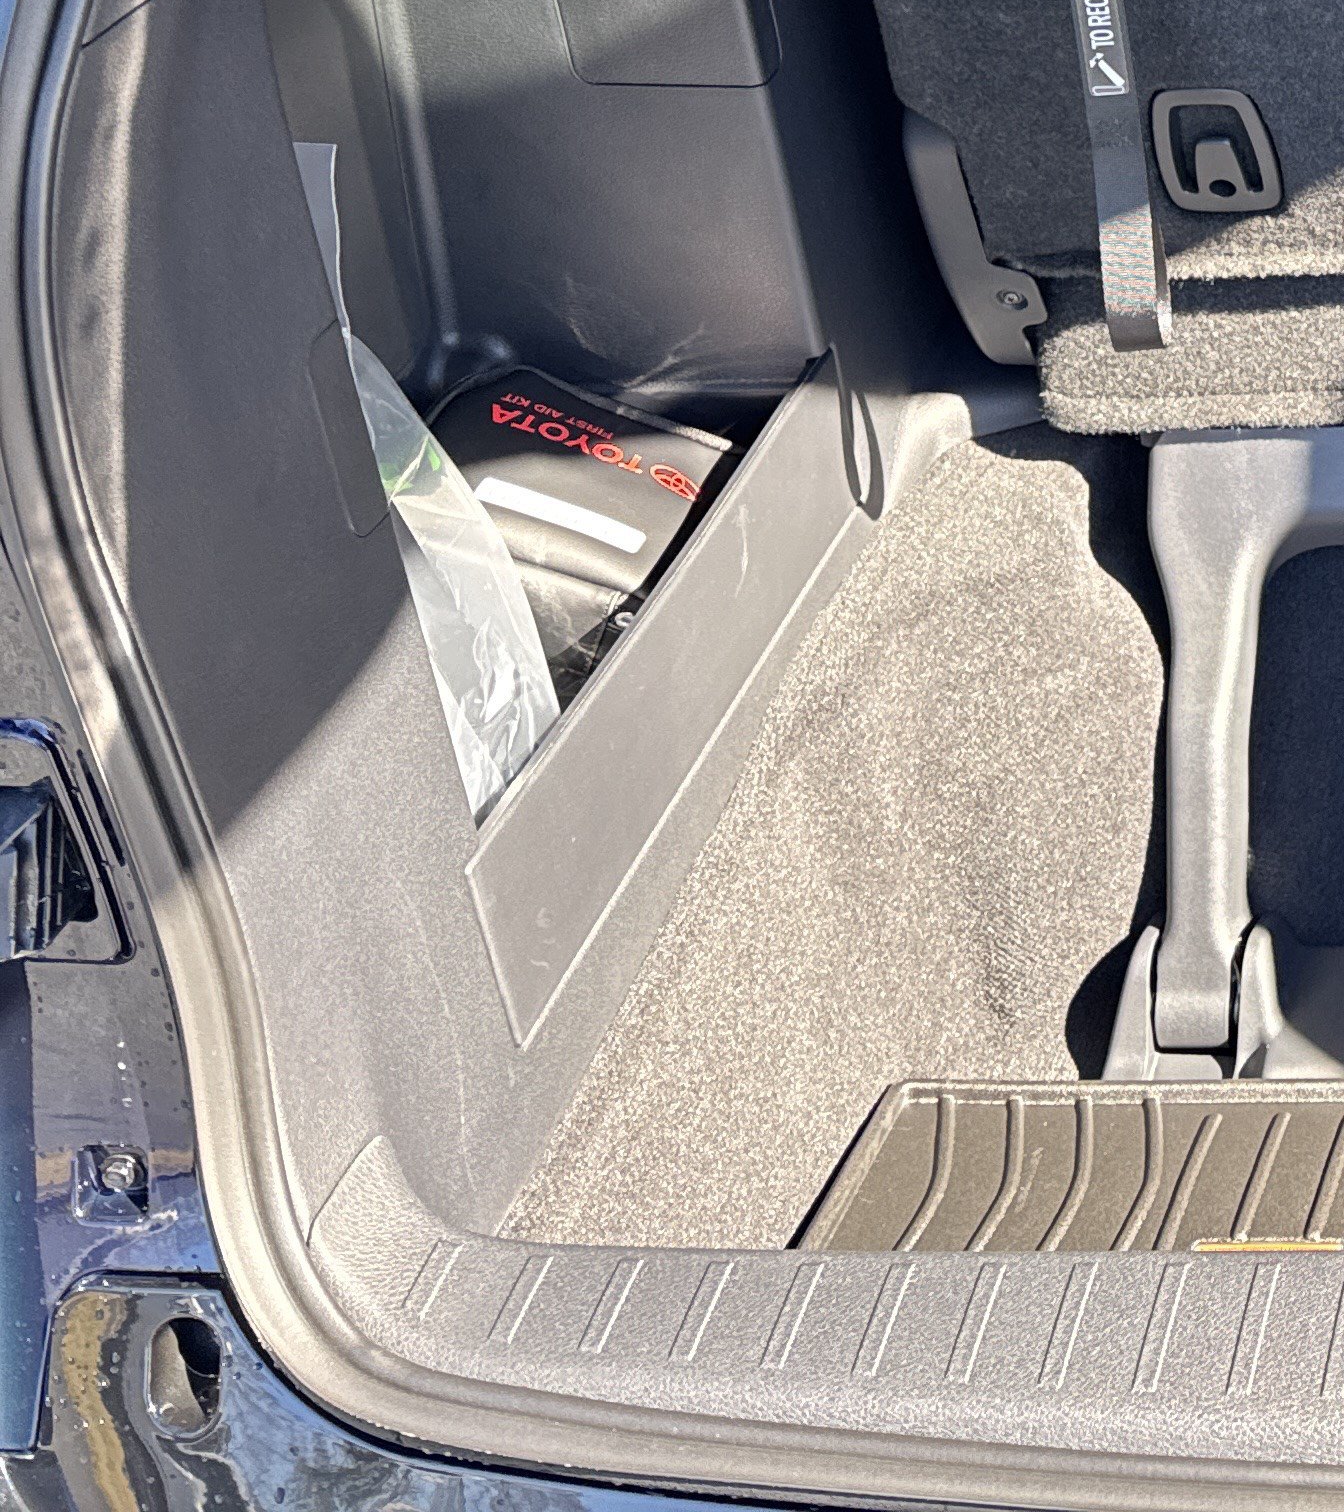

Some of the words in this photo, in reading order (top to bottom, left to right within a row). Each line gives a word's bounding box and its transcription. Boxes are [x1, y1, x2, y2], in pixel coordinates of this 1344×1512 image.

[1090, 28, 1115, 50] TO
[500, 392, 531, 407] KIT
[534, 403, 566, 419] AID
[491, 403, 644, 474] TOYOTA
[565, 416, 615, 441] FIRST
